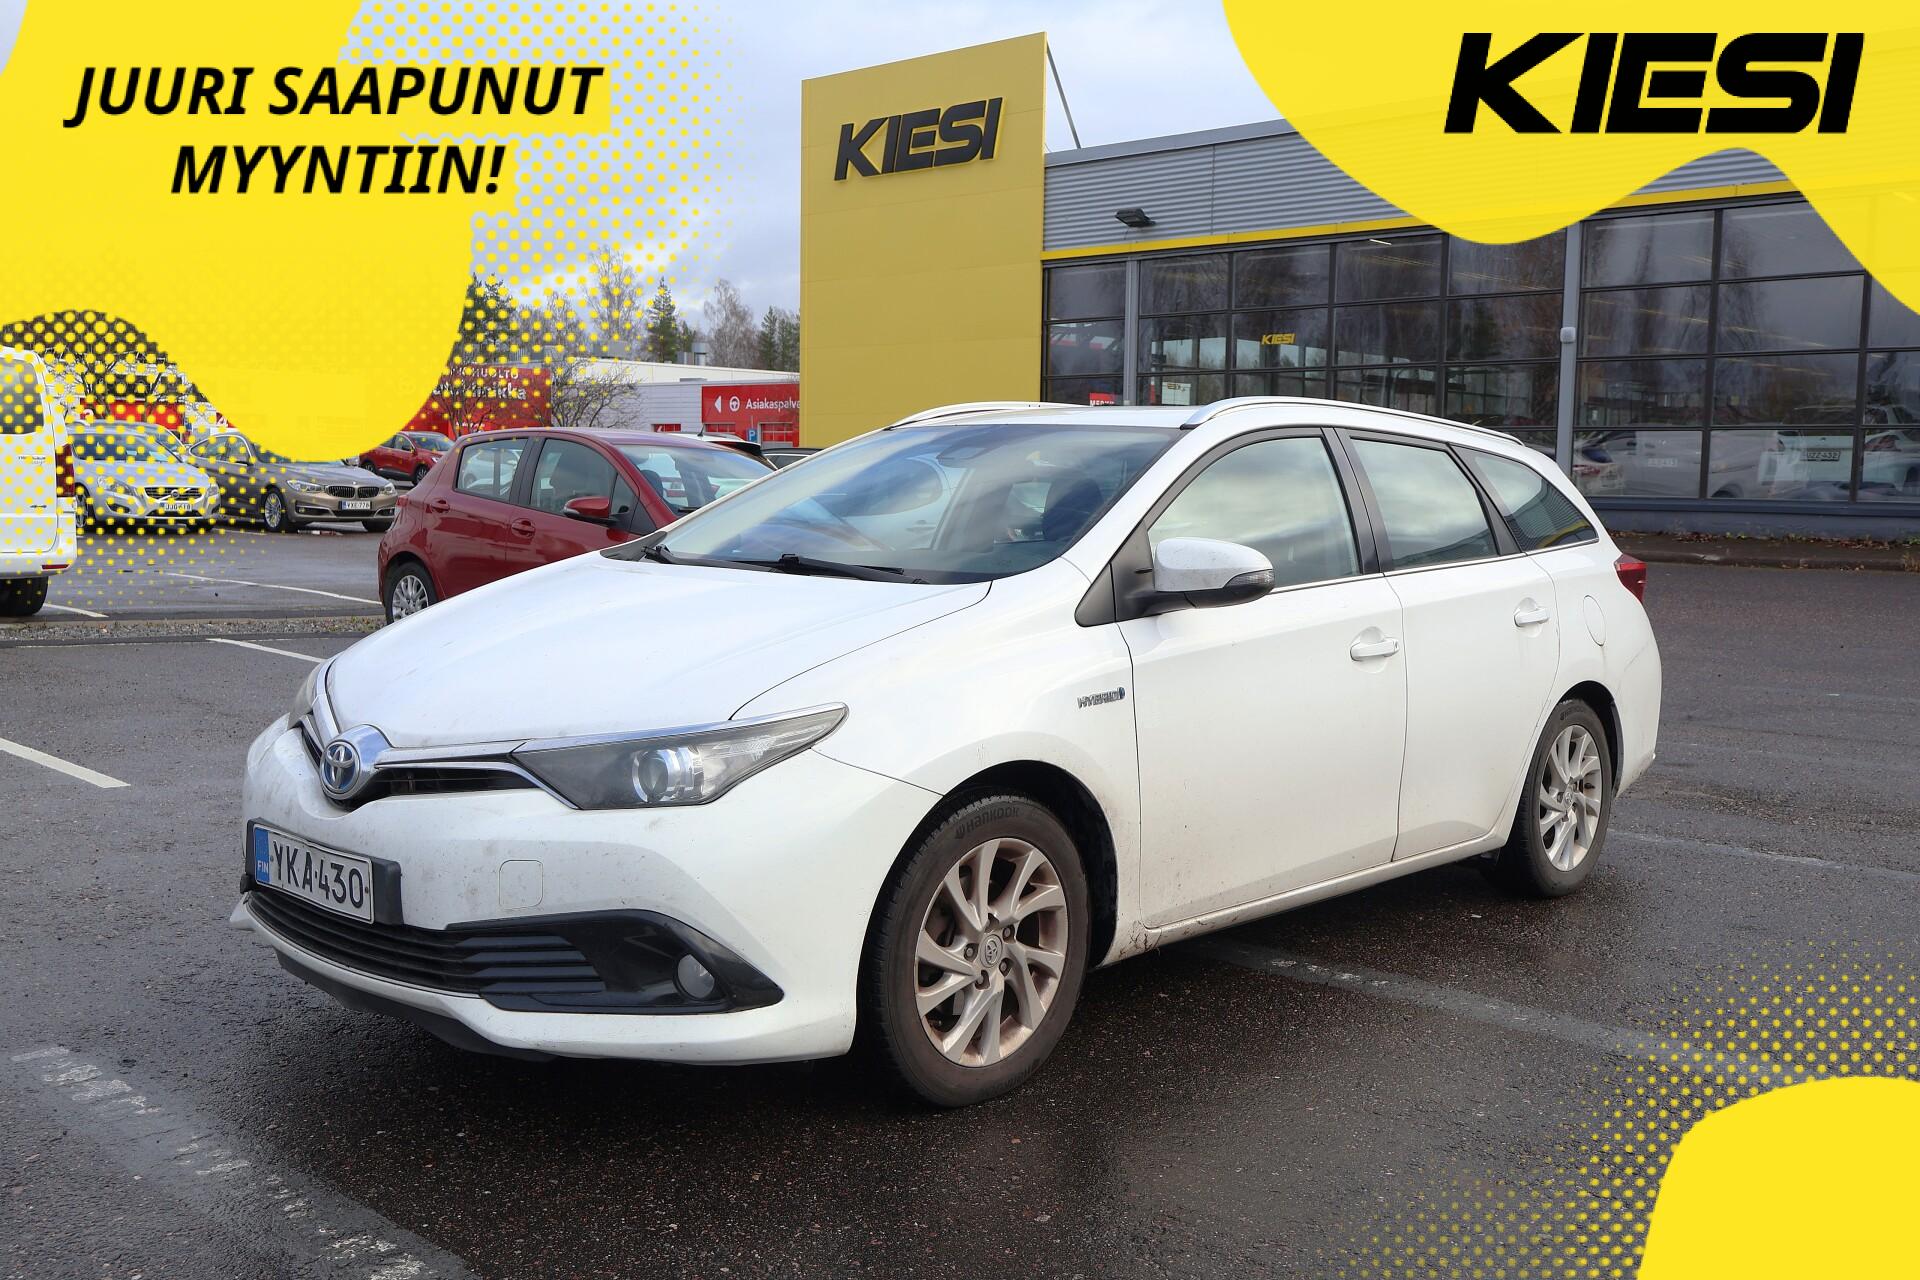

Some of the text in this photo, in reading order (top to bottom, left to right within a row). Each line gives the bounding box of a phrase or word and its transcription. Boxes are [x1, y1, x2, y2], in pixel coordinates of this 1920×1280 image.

[834, 97, 1003, 181] KIESI
[1262, 333, 1296, 345] KIESI
[1077, 687, 1125, 709] HYBRID
[257, 840, 364, 909] FIN YKA-430
